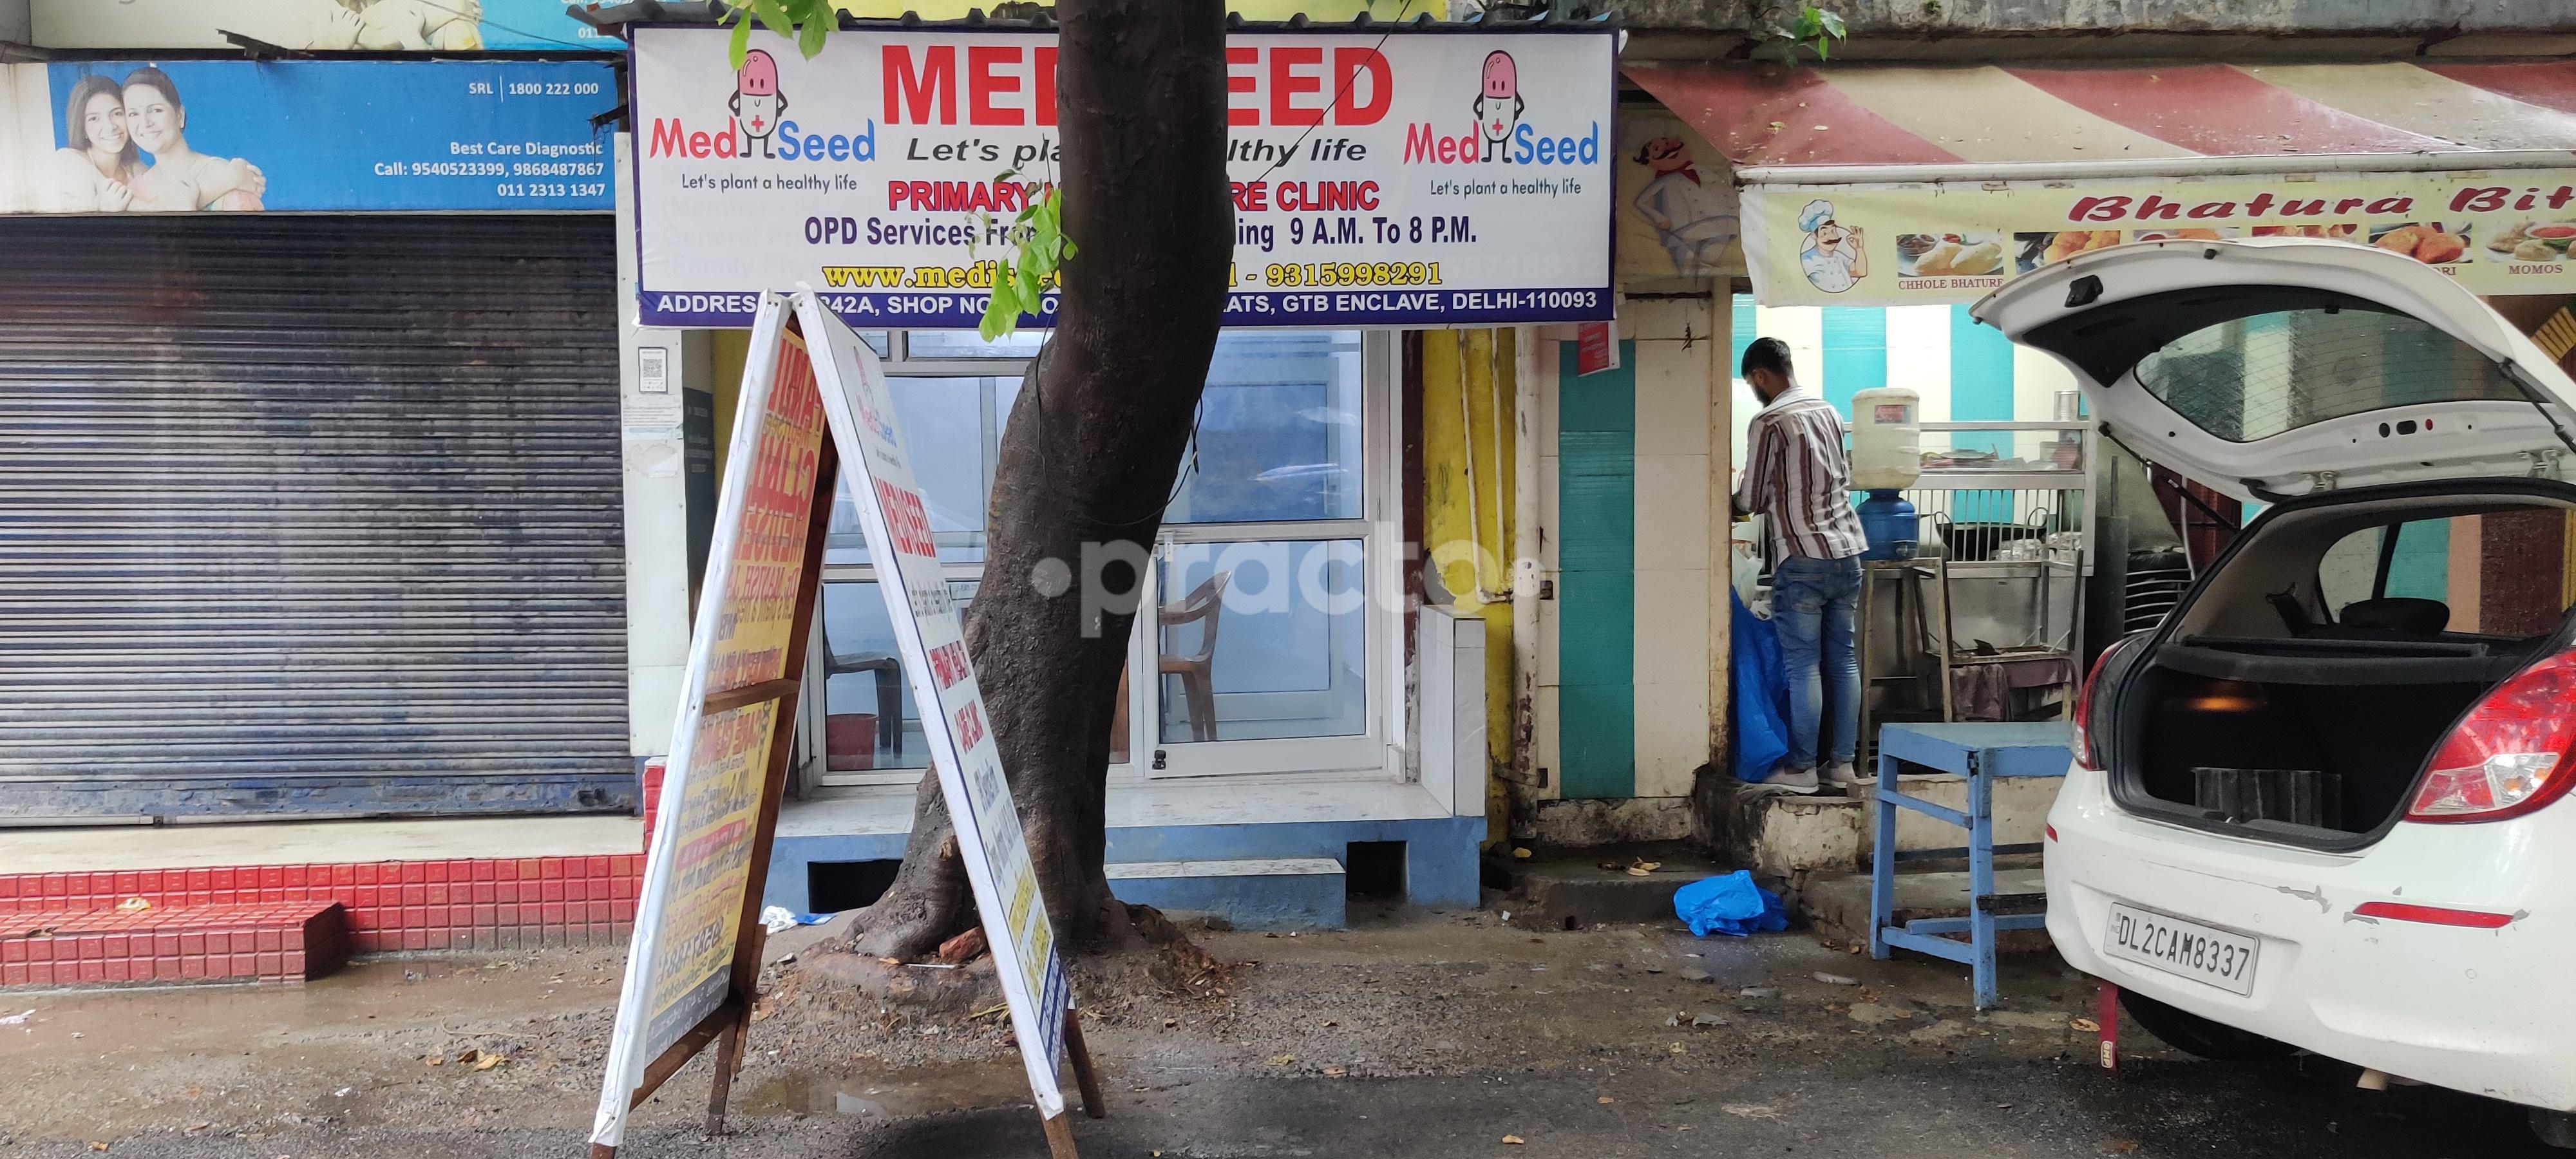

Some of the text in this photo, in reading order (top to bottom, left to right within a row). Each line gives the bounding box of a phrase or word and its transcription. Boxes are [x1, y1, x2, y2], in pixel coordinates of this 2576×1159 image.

[469, 82, 599, 95] SRL 1800 222 000
[451, 141, 603, 158] Best Care Diagnostic
[649, 115, 875, 162] Med Seed
[907, 138, 999, 161] Let's
[1311, 138, 1367, 161] life
[1403, 119, 1598, 165] Med Seed
[374, 162, 604, 178] Call: 9540523399, 9868487867
[497, 184, 605, 196] 011 2313 1347
[682, 173, 857, 194] Let's plant a healthy life
[1430, 177, 1581, 200] Let's plant a healthy life
[889, 180, 1037, 211] PRIMARY
[1276, 180, 1379, 211] CLINIC
[2068, 193, 2414, 221] Bhatura
[805, 216, 857, 244] OPD
[867, 216, 975, 245] Services
[1291, 217, 1303, 245] 9
[1312, 217, 1363, 244] A.M.
[1372, 216, 1400, 243] To
[1410, 216, 1422, 243] 8
[1432, 216, 1477, 243] P.M.
[1265, 261, 1443, 287] 9315998291
[2508, 265, 2563, 274] MOMOS
[1899, 279, 1947, 290] CHHOLE
[657, 295, 757, 313] ADDRES
[887, 296, 952, 314] SHOP
[1283, 294, 1329, 312] GTB
[1336, 293, 1445, 313] ENCLAVE,
[1452, 291, 1597, 310] DELHI-110093
[873, 475, 937, 558] MEDISEED
[2119, 915, 2250, 981] DL2CAM8337
